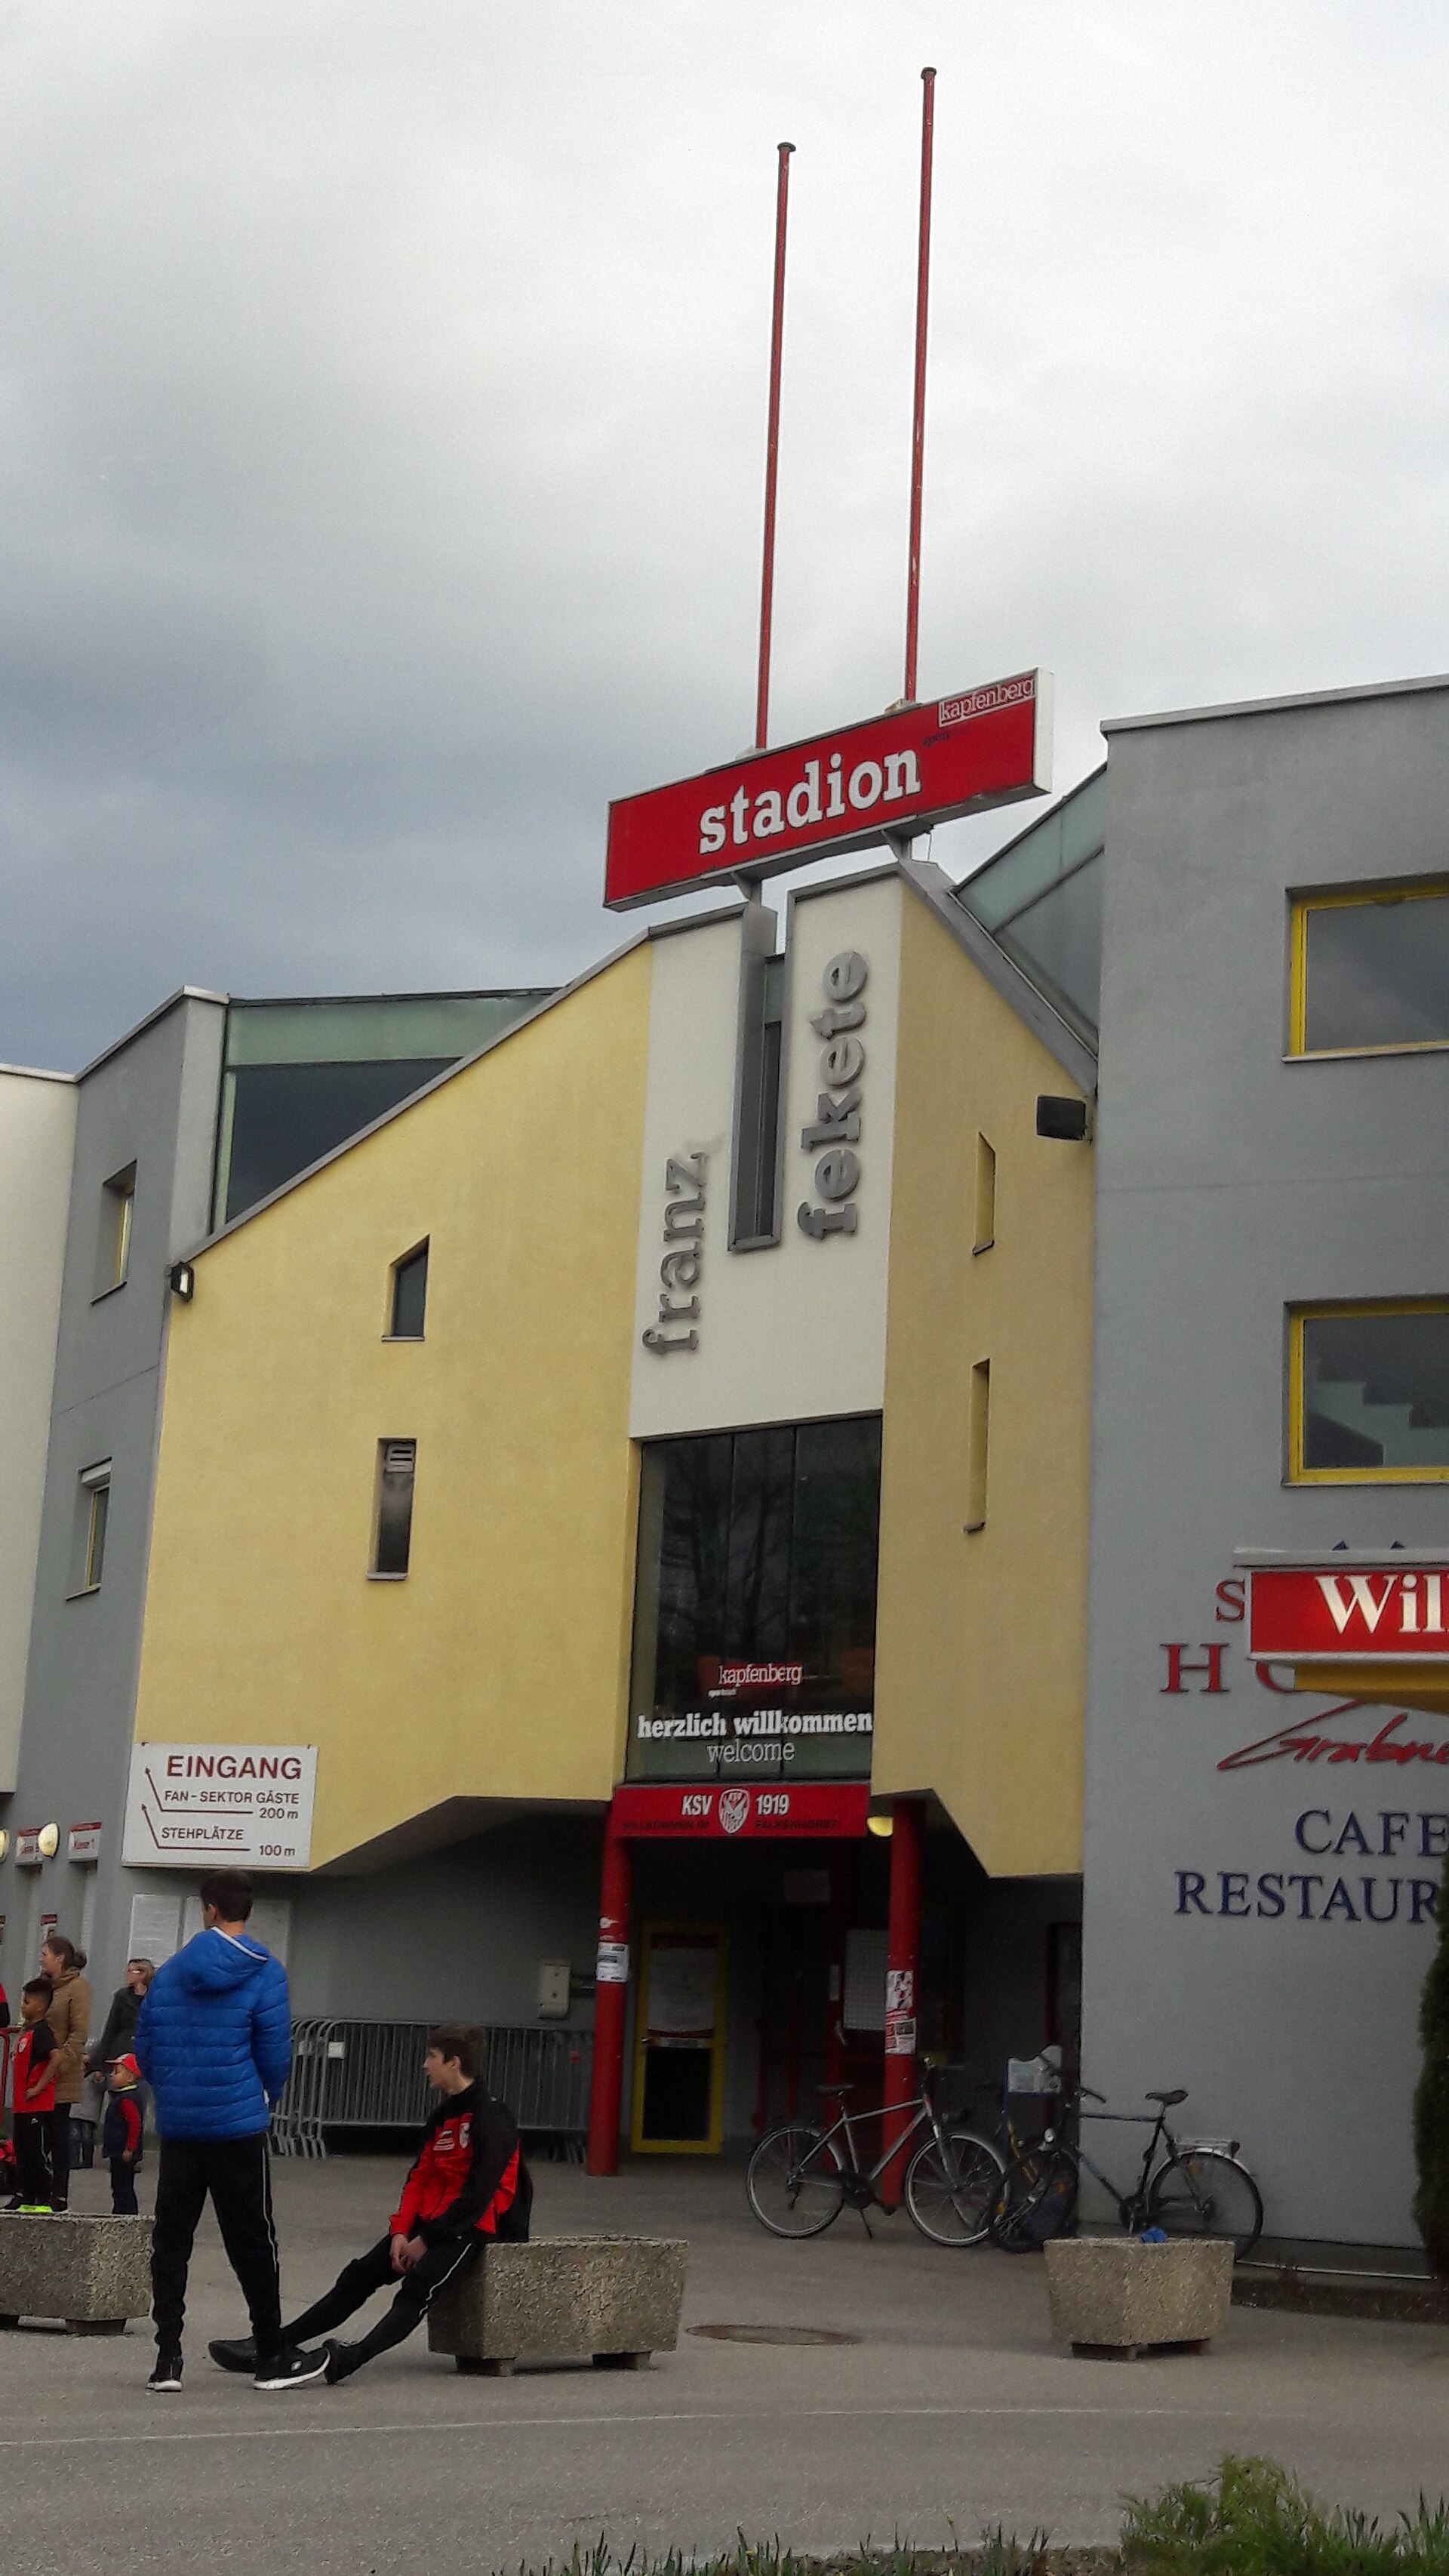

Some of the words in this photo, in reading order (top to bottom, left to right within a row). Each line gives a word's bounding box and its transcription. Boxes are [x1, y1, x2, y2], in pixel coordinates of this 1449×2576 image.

[940, 679, 1034, 719] kapfenberg
[699, 748, 922, 854] stadion
[797, 950, 867, 1240] fekete
[642, 1152, 706, 1354] franz
[1315, 1574, 1449, 1635] Wil
[718, 1663, 803, 1687] kapfenberg
[637, 1712, 728, 1739] herzlich
[733, 1709, 873, 1735] willkommen
[706, 1738, 795, 1763] welcome
[166, 1755, 303, 1780] EINGANG
[256, 1790, 300, 1805] GÄSTE
[681, 1794, 713, 1816] KSV
[755, 1794, 790, 1816] 1919
[259, 1808, 285, 1820] 200
[287, 1810, 299, 1820] m
[161, 1826, 245, 1840] STEHPLÄTZE
[259, 1845, 282, 1857] 100
[284, 1847, 296, 1857] m
